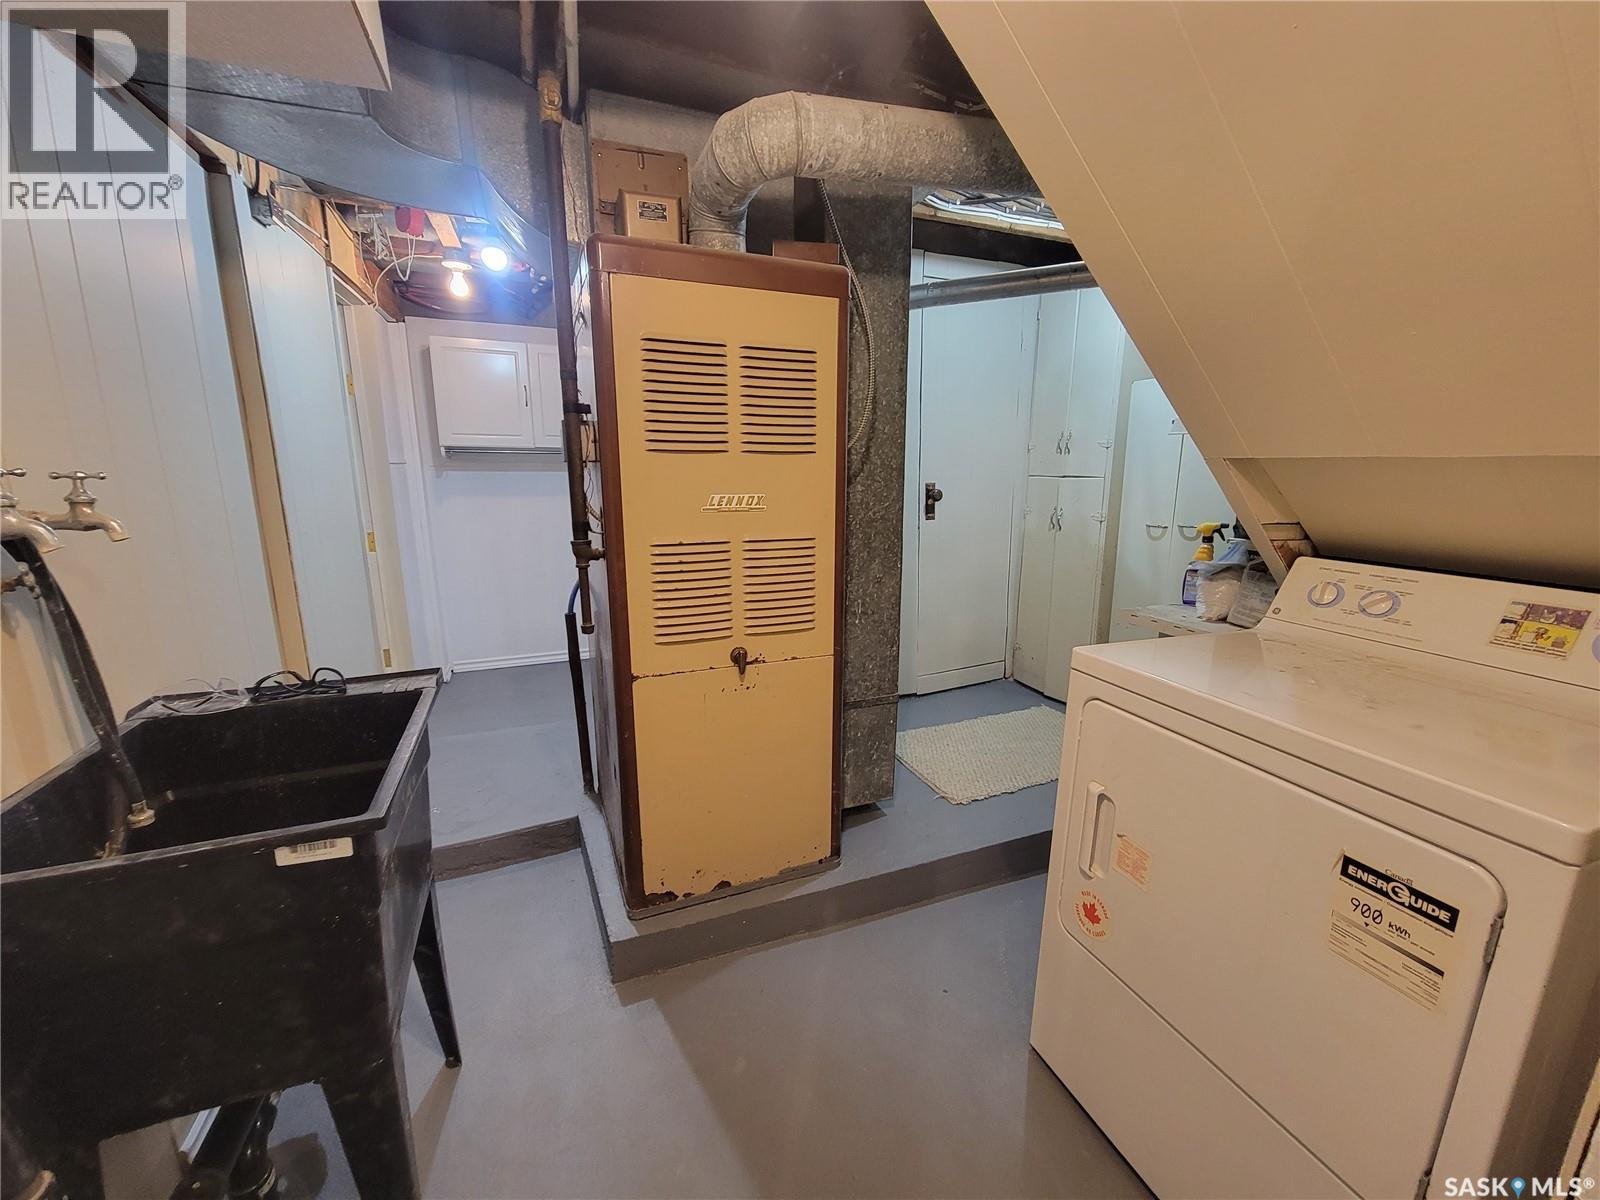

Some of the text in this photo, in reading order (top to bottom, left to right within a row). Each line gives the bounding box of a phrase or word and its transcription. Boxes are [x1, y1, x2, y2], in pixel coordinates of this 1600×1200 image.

[708, 495, 765, 507] LENNOX
[1350, 897, 1383, 925] 900
[1388, 921, 1411, 939] kWh
